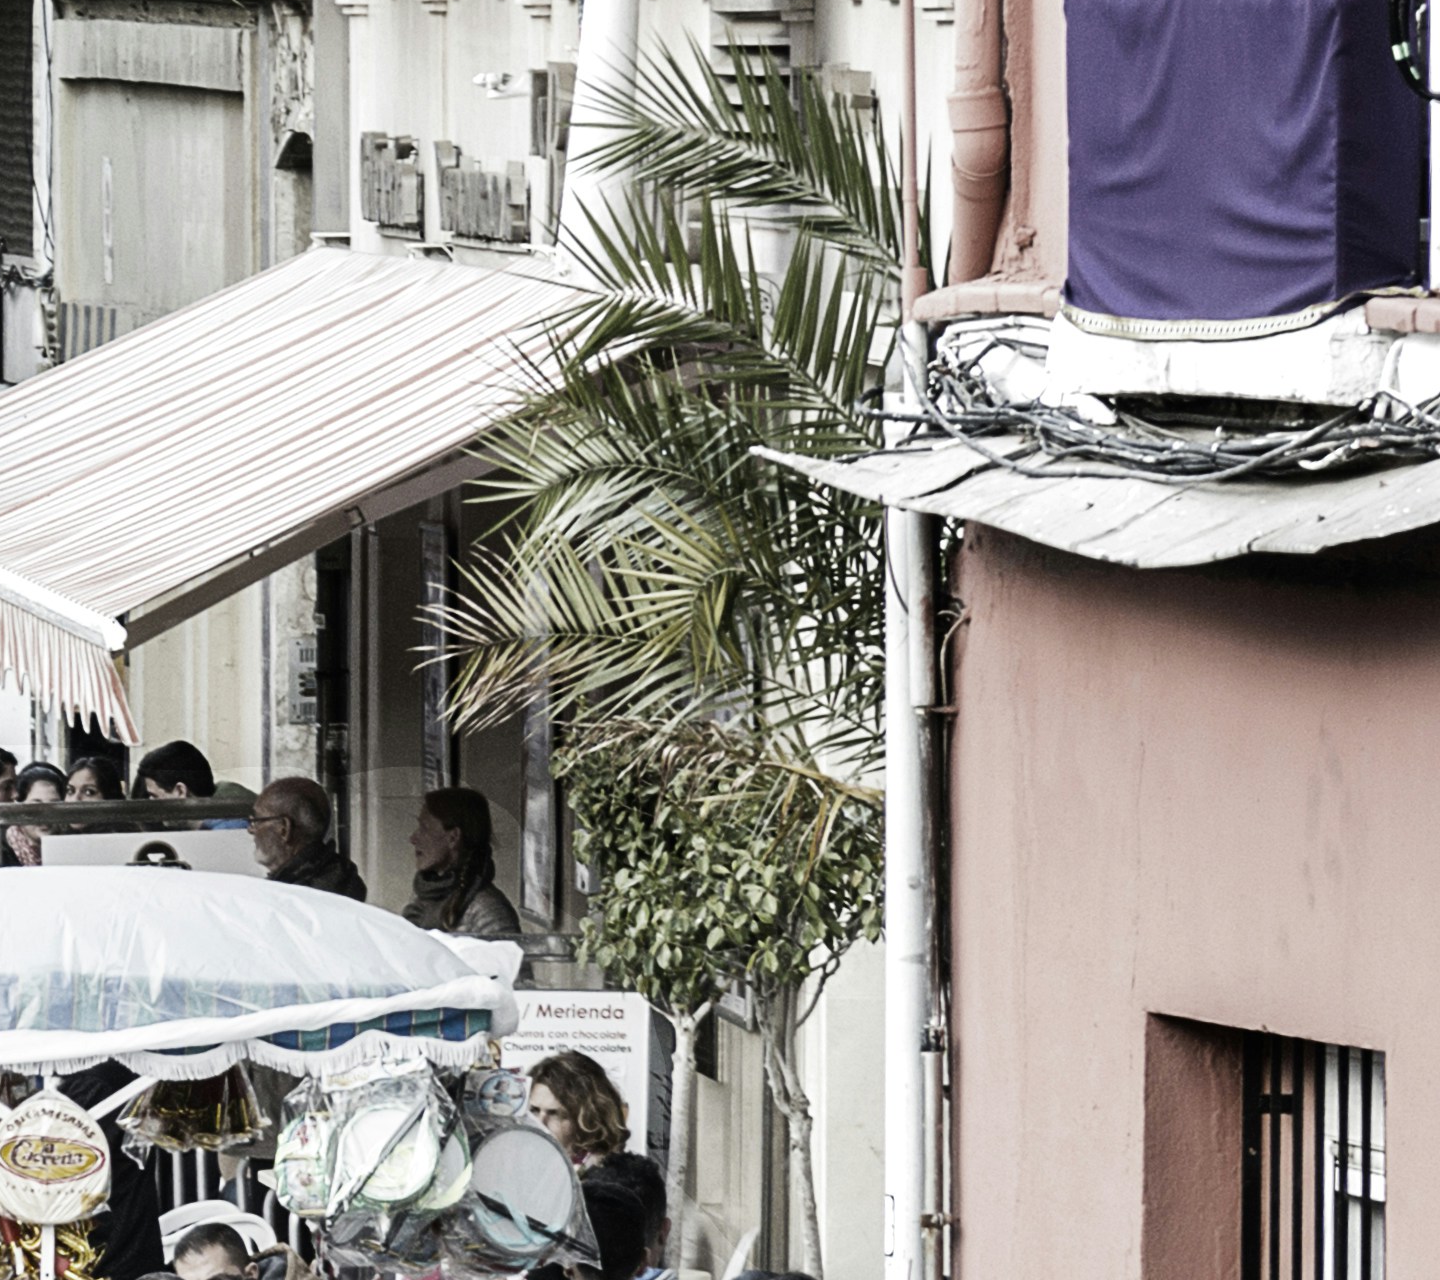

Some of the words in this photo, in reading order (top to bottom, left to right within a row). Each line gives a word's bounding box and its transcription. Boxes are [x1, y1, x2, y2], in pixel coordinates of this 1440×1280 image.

[536, 1004, 625, 1020] Merienda
[512, 1030, 545, 1039] hurros
[548, 1031, 569, 1039] con
[572, 1029, 628, 1039] chocolate
[503, 1041, 545, 1052] Churros
[548, 1043, 569, 1052] with
